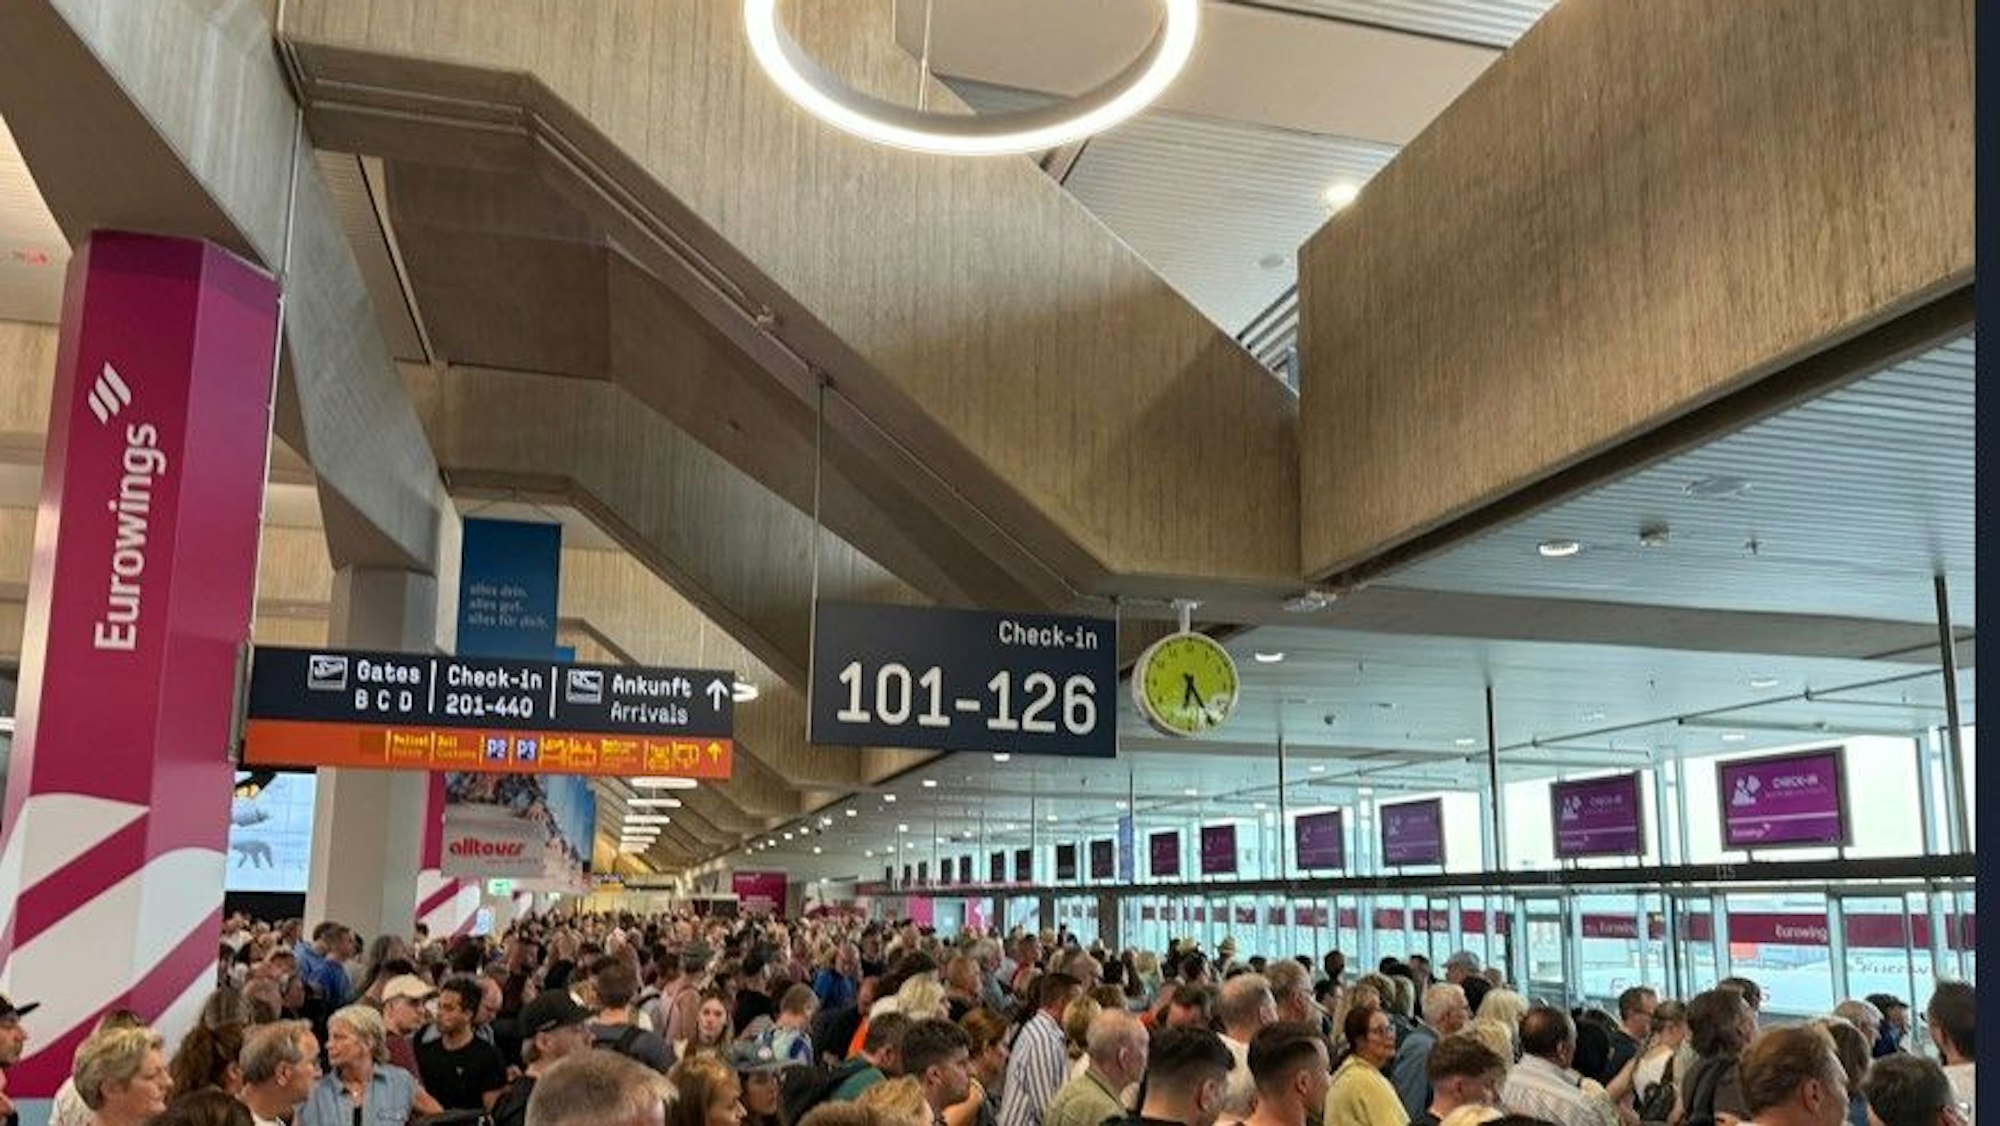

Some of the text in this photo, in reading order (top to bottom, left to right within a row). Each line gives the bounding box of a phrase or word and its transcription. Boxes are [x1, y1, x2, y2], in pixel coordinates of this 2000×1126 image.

[94, 423, 167, 651] Eurowings
[999, 620, 1098, 650] Check-in
[357, 659, 421, 684] Gates
[448, 663, 543, 690] Check-in
[612, 673, 692, 698] Ankunft
[836, 660, 1098, 736] 101-126
[355, 688, 413, 712] B C D
[445, 693, 534, 718] 201-440
[610, 701, 689, 725] Arrivals
[486, 738, 507, 760] P2
[516, 739, 537, 761] P3
[449, 836, 525, 856] alltours
